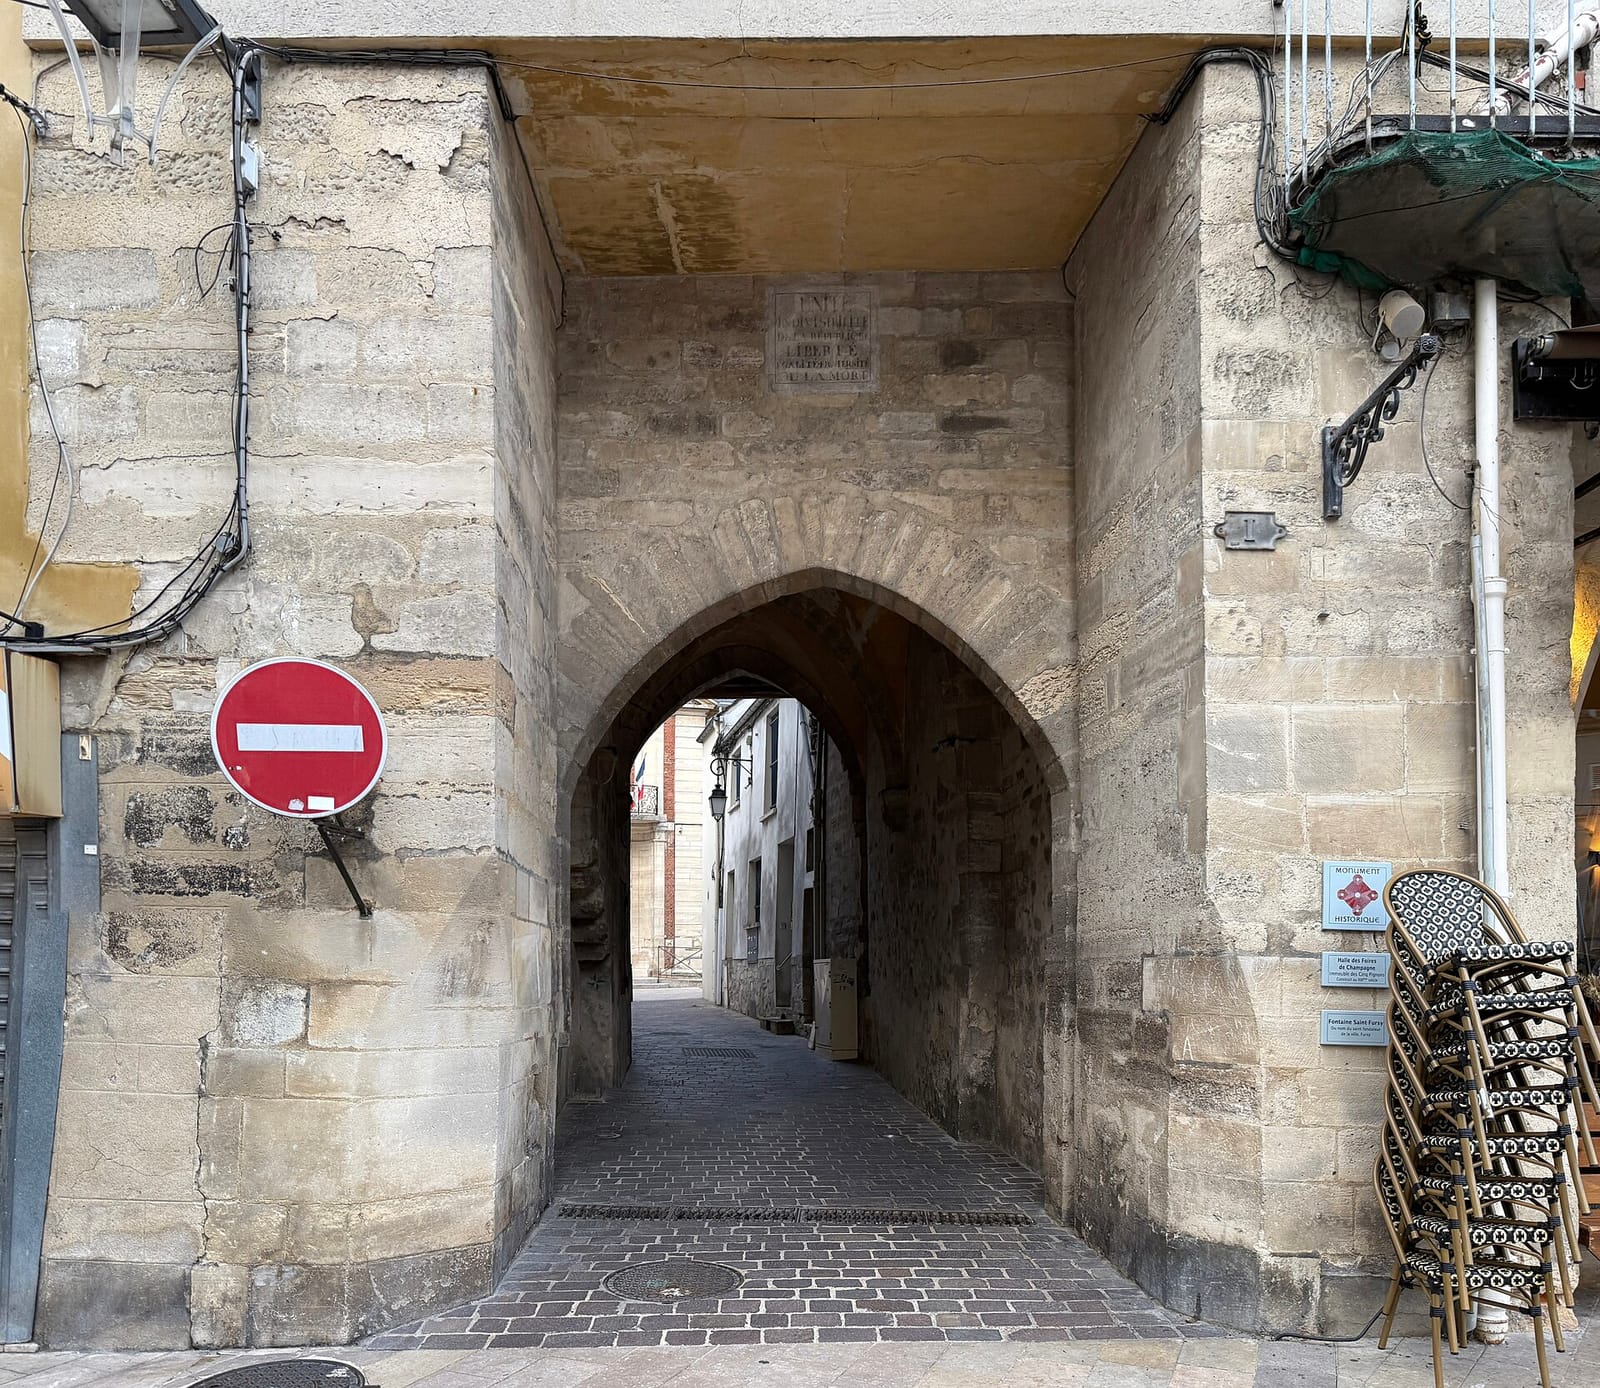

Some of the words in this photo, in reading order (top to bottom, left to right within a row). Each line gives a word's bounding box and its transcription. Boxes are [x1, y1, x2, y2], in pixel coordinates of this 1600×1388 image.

[827, 371, 869, 382] MORT
[1334, 916, 1381, 924] HISTORIQUE
[1346, 964, 1376, 972] Champagne
[1182, 1035, 1194, 1061] A
